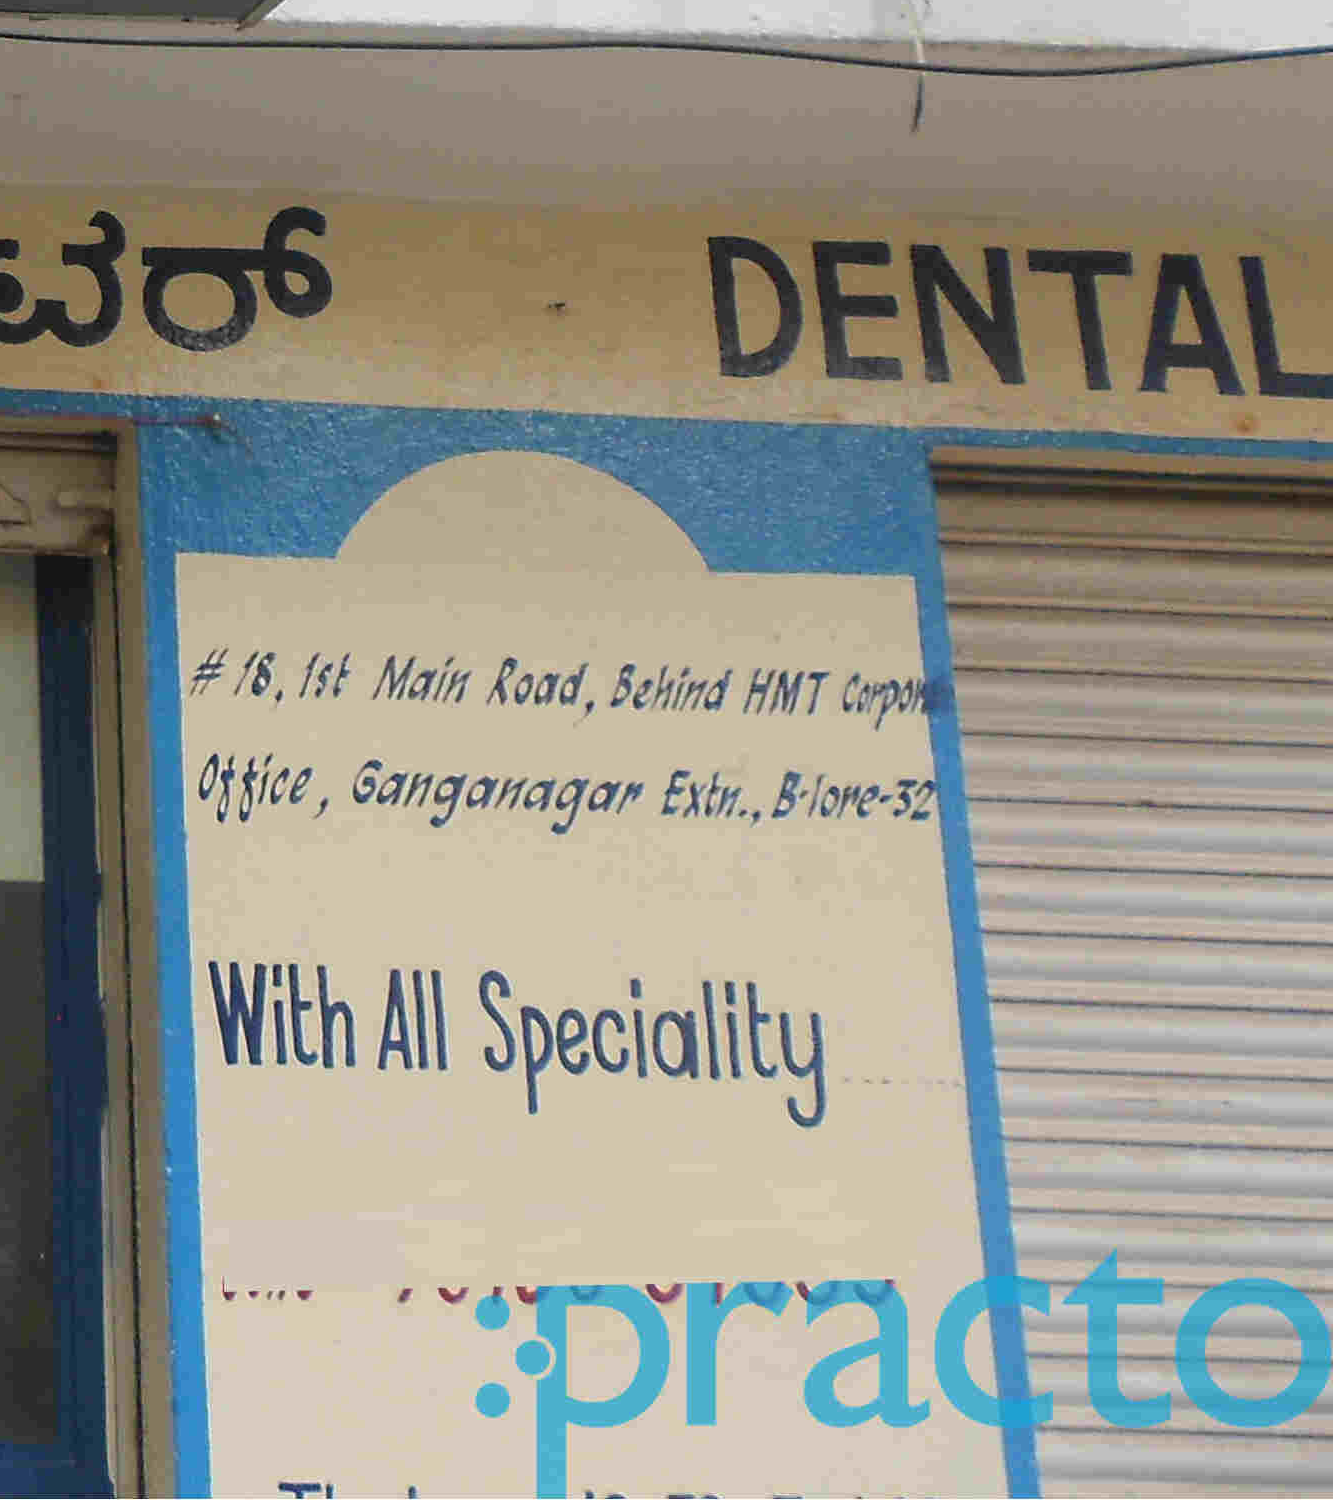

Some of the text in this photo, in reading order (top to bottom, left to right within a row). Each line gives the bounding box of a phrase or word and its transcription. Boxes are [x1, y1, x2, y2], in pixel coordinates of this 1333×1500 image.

[707, 236, 1333, 400] DENTAL
[373, 653, 471, 703] Main
[486, 657, 594, 720] Road,
[610, 662, 728, 713] Behind
[743, 667, 830, 717] HMT
[198, 752, 329, 823] Office,
[351, 758, 643, 835] Ganganagar
[207, 960, 826, 1130] With All Speciality
